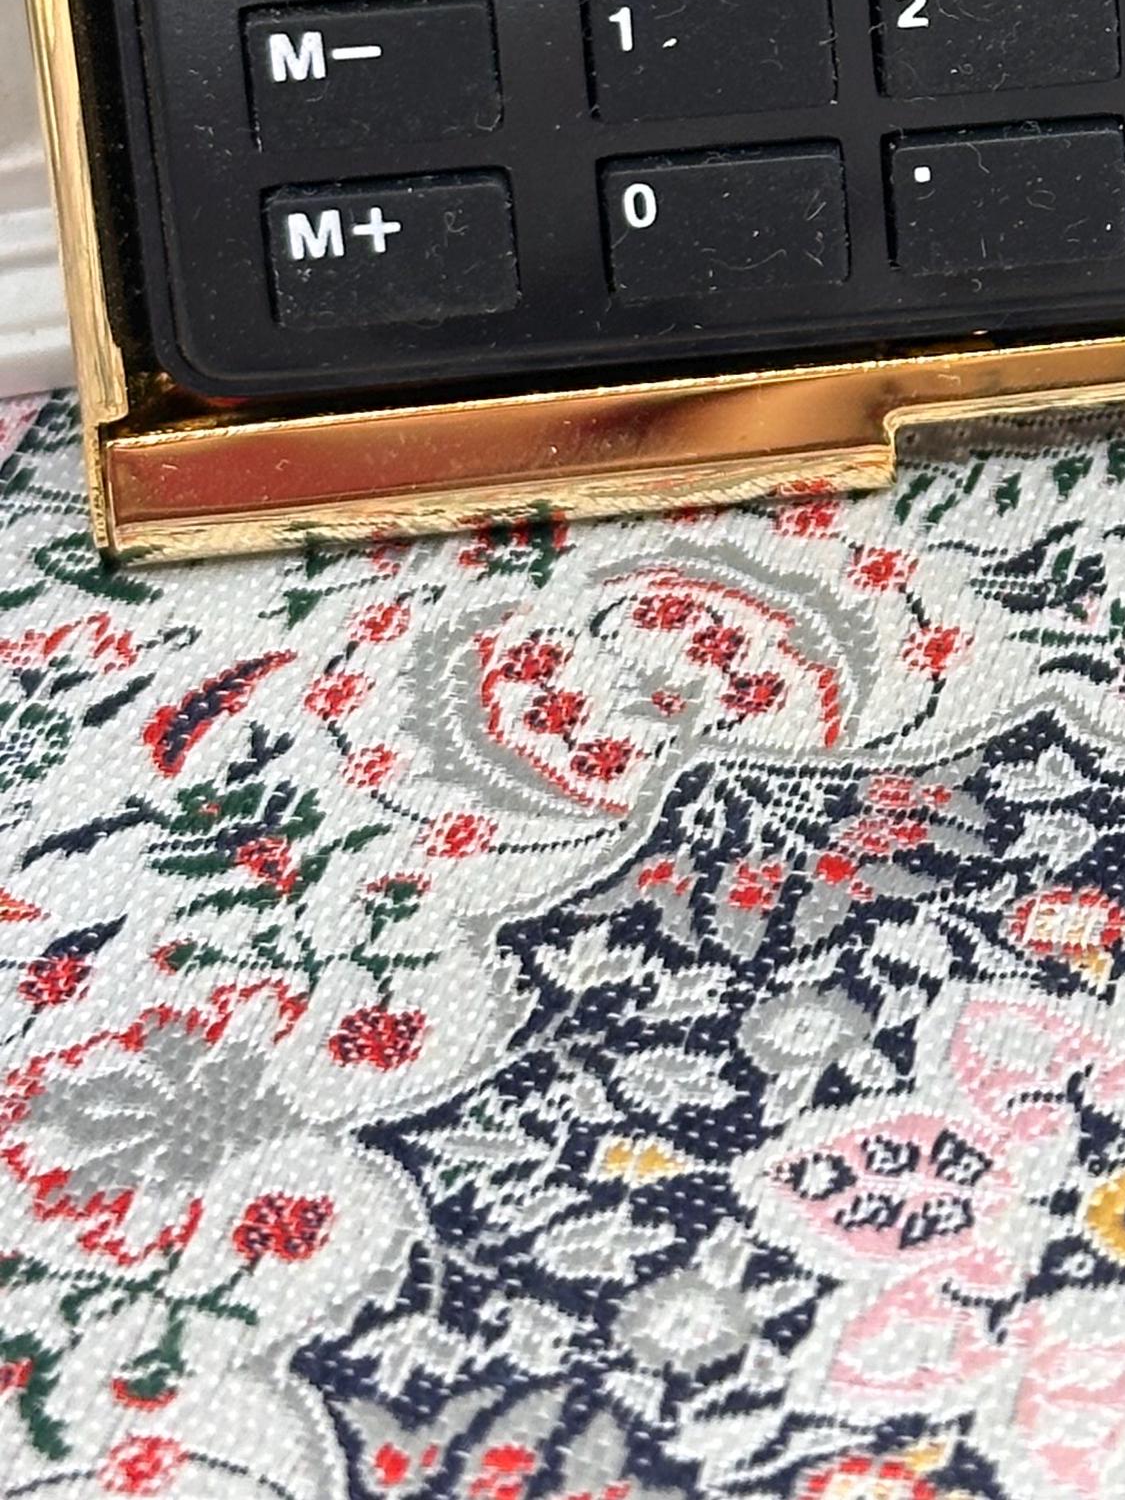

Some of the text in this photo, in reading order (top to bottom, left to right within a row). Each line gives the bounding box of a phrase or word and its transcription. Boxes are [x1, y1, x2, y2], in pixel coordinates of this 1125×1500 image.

[608, 6, 633, 52] 1
[622, 183, 657, 229] 0
[286, 207, 401, 261] M+
